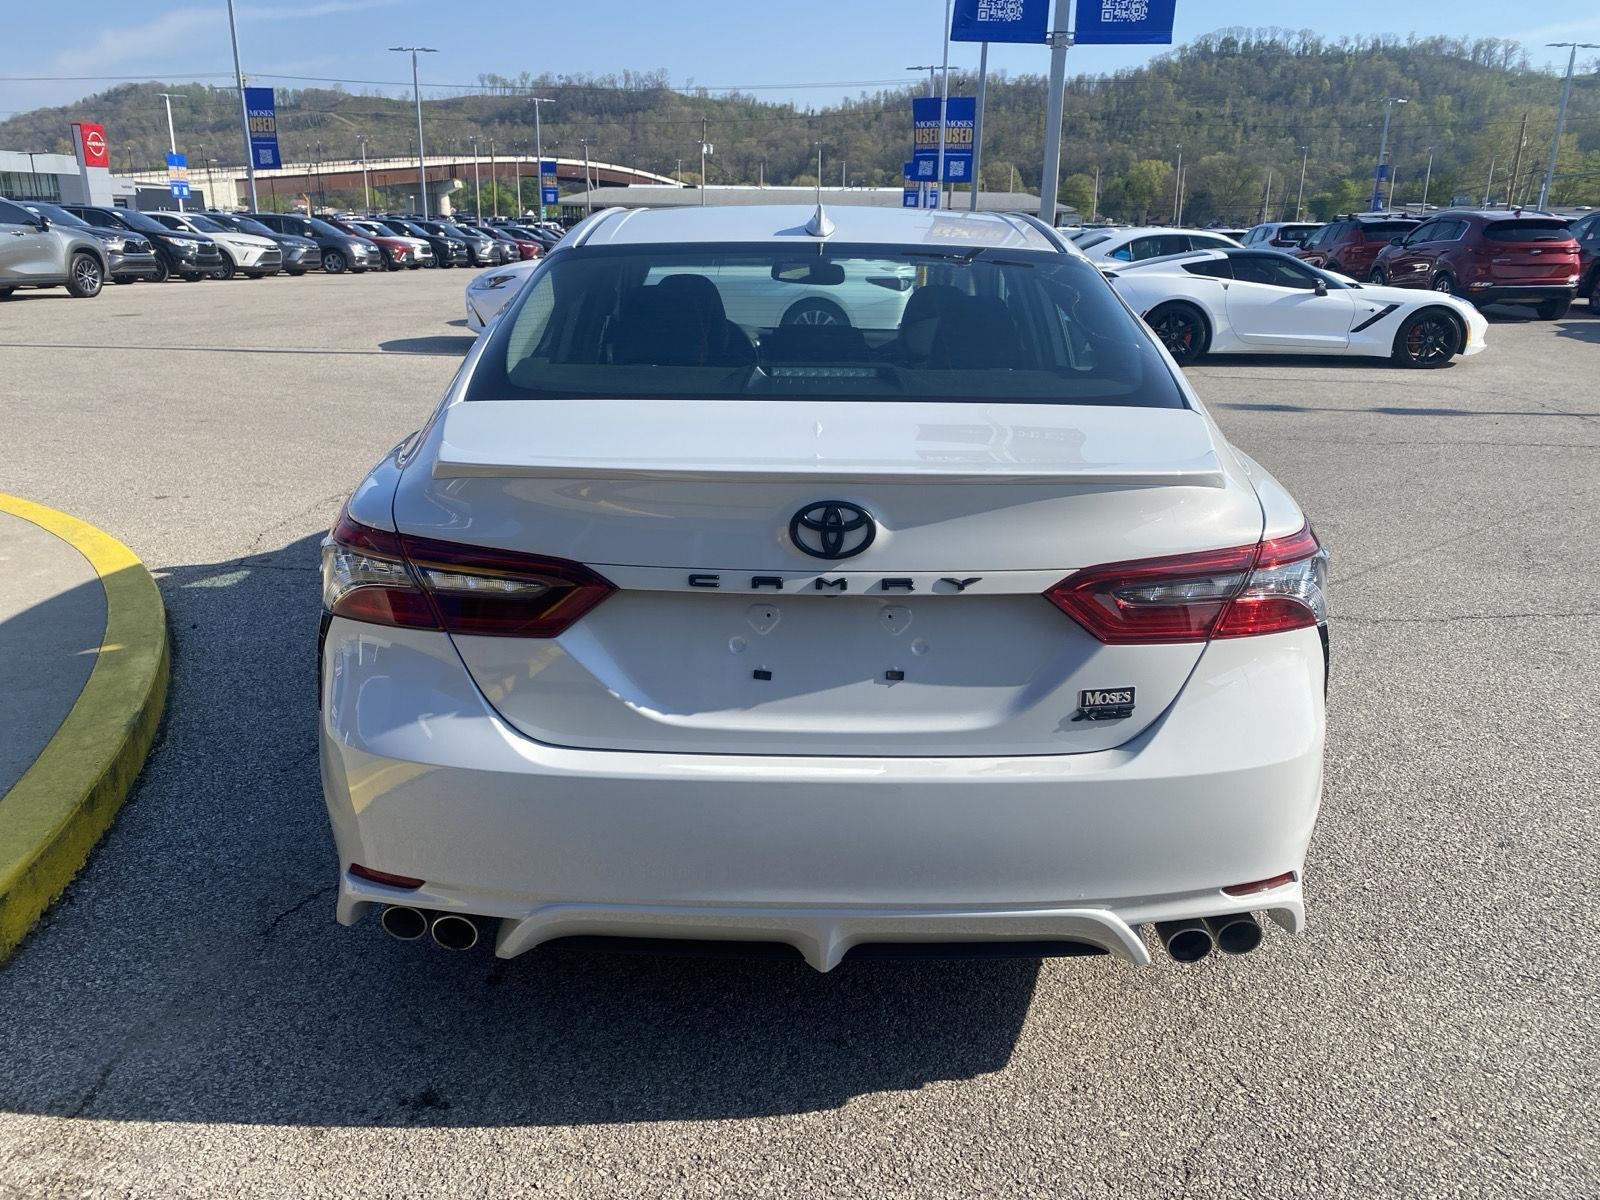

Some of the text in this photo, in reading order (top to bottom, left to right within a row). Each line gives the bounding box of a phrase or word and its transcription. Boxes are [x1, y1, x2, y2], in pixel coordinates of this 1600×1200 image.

[249, 116, 275, 132] USED
[946, 120, 973, 128] MOSES
[945, 127, 973, 144] USED
[688, 573, 983, 591] CAMRY
[1085, 691, 1131, 706] MOSES
